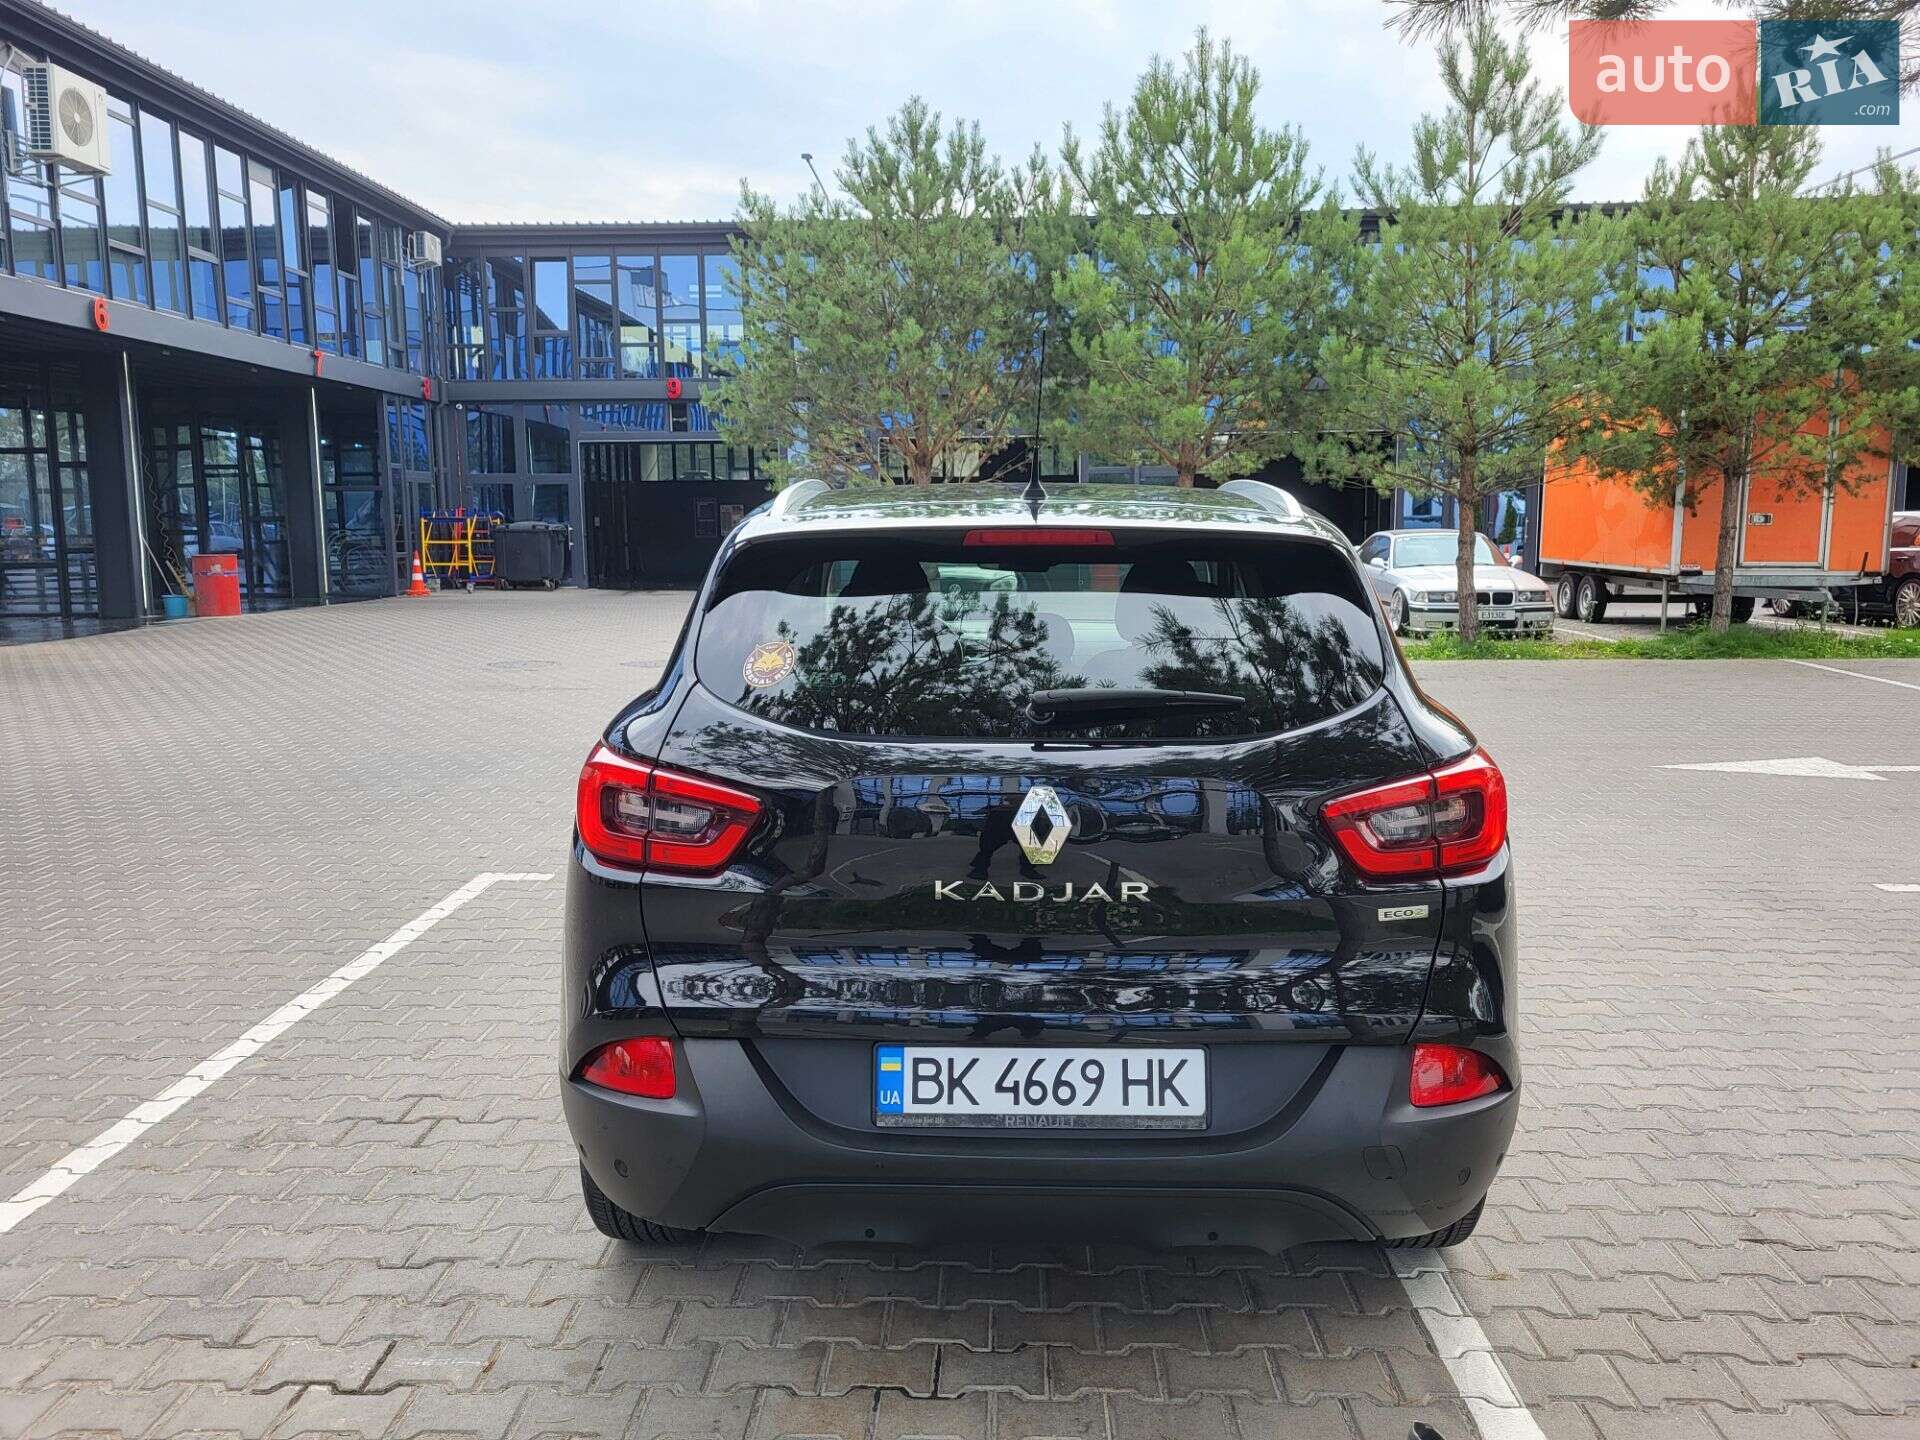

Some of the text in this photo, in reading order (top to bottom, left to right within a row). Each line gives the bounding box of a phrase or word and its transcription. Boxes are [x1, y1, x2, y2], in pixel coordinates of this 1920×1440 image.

[94, 296, 110, 331] 6
[313, 350, 324, 377] 7
[666, 377, 681, 400] 9
[934, 879, 1151, 902] KADJAR
[911, 1057, 1190, 1107] BK 4669 HK
[880, 1090, 901, 1105] UA
[1005, 1115, 1076, 1128] RENAULT
